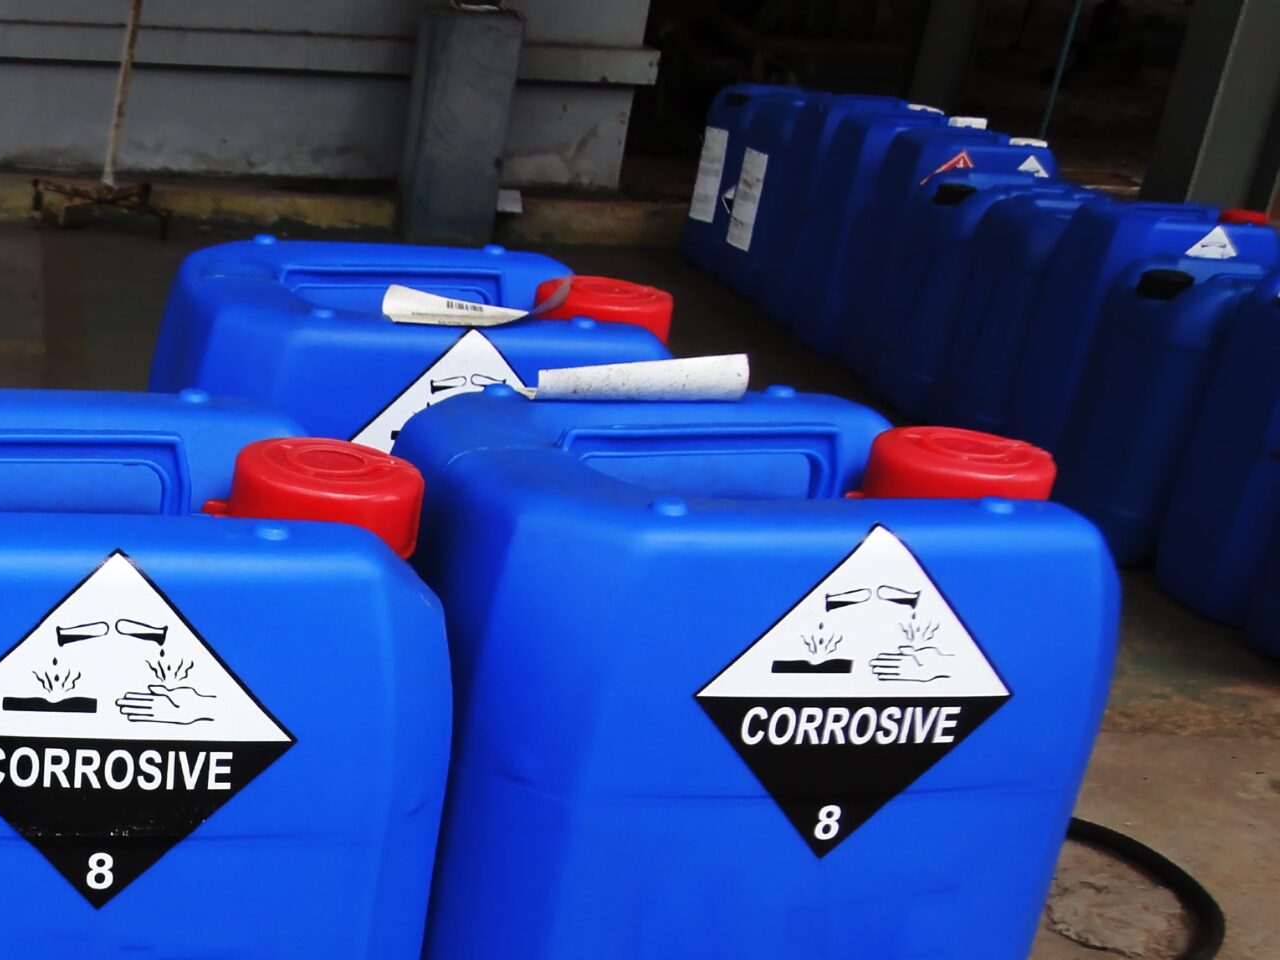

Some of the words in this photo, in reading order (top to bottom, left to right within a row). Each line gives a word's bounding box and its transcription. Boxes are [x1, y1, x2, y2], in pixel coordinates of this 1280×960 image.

[740, 706, 962, 746] CORROSIVE
[813, 804, 842, 841] 8
[85, 852, 114, 890] 8
